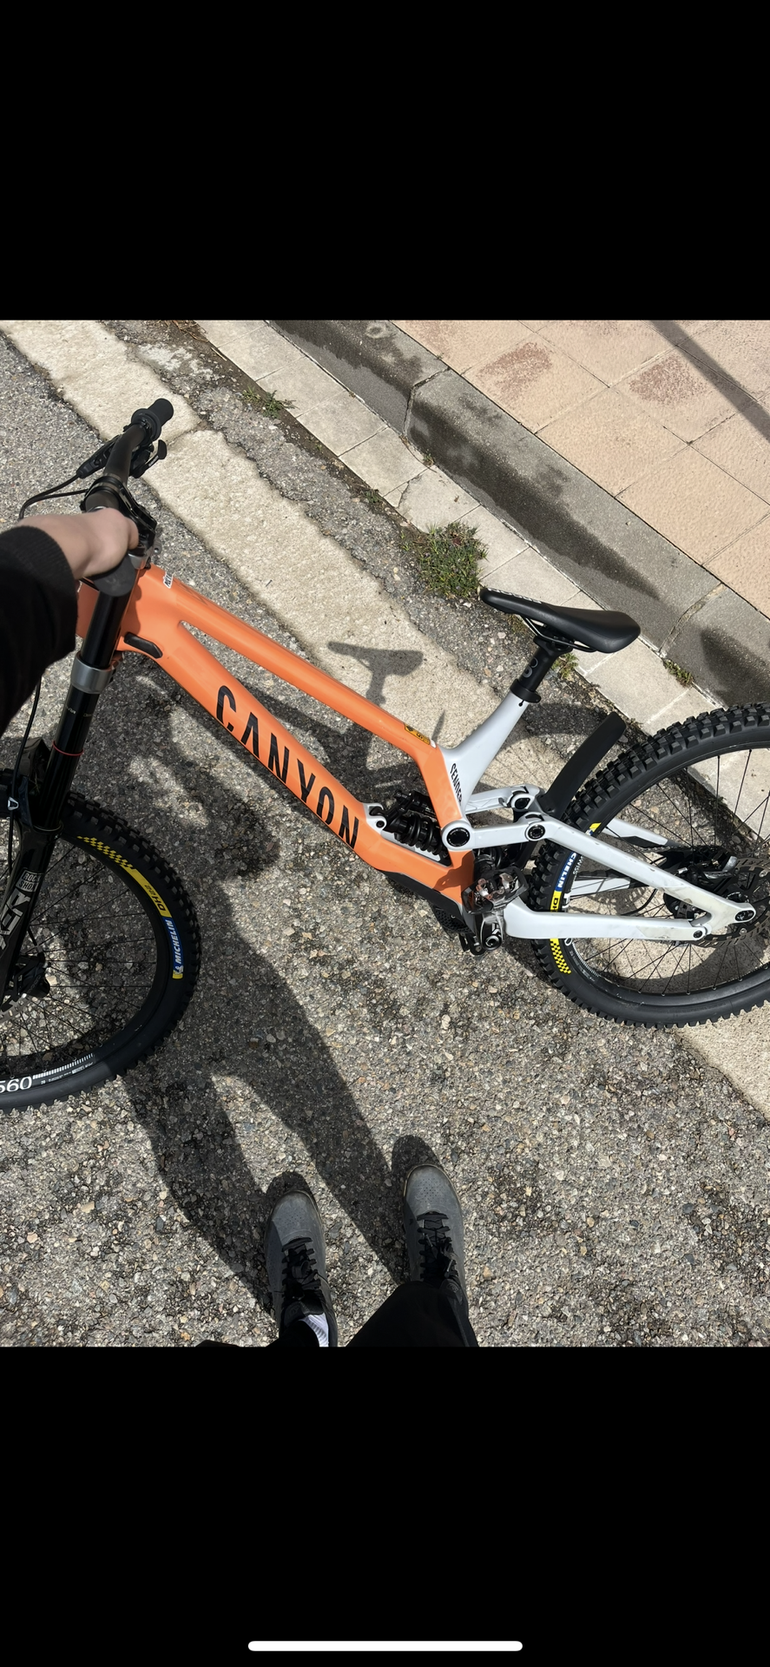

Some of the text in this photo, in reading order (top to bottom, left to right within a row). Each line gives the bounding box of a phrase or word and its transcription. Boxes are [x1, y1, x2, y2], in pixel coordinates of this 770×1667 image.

[216, 685, 359, 849] CANYON
[558, 852, 577, 888] CHELIN
[165, 919, 182, 965] MICHELIN
